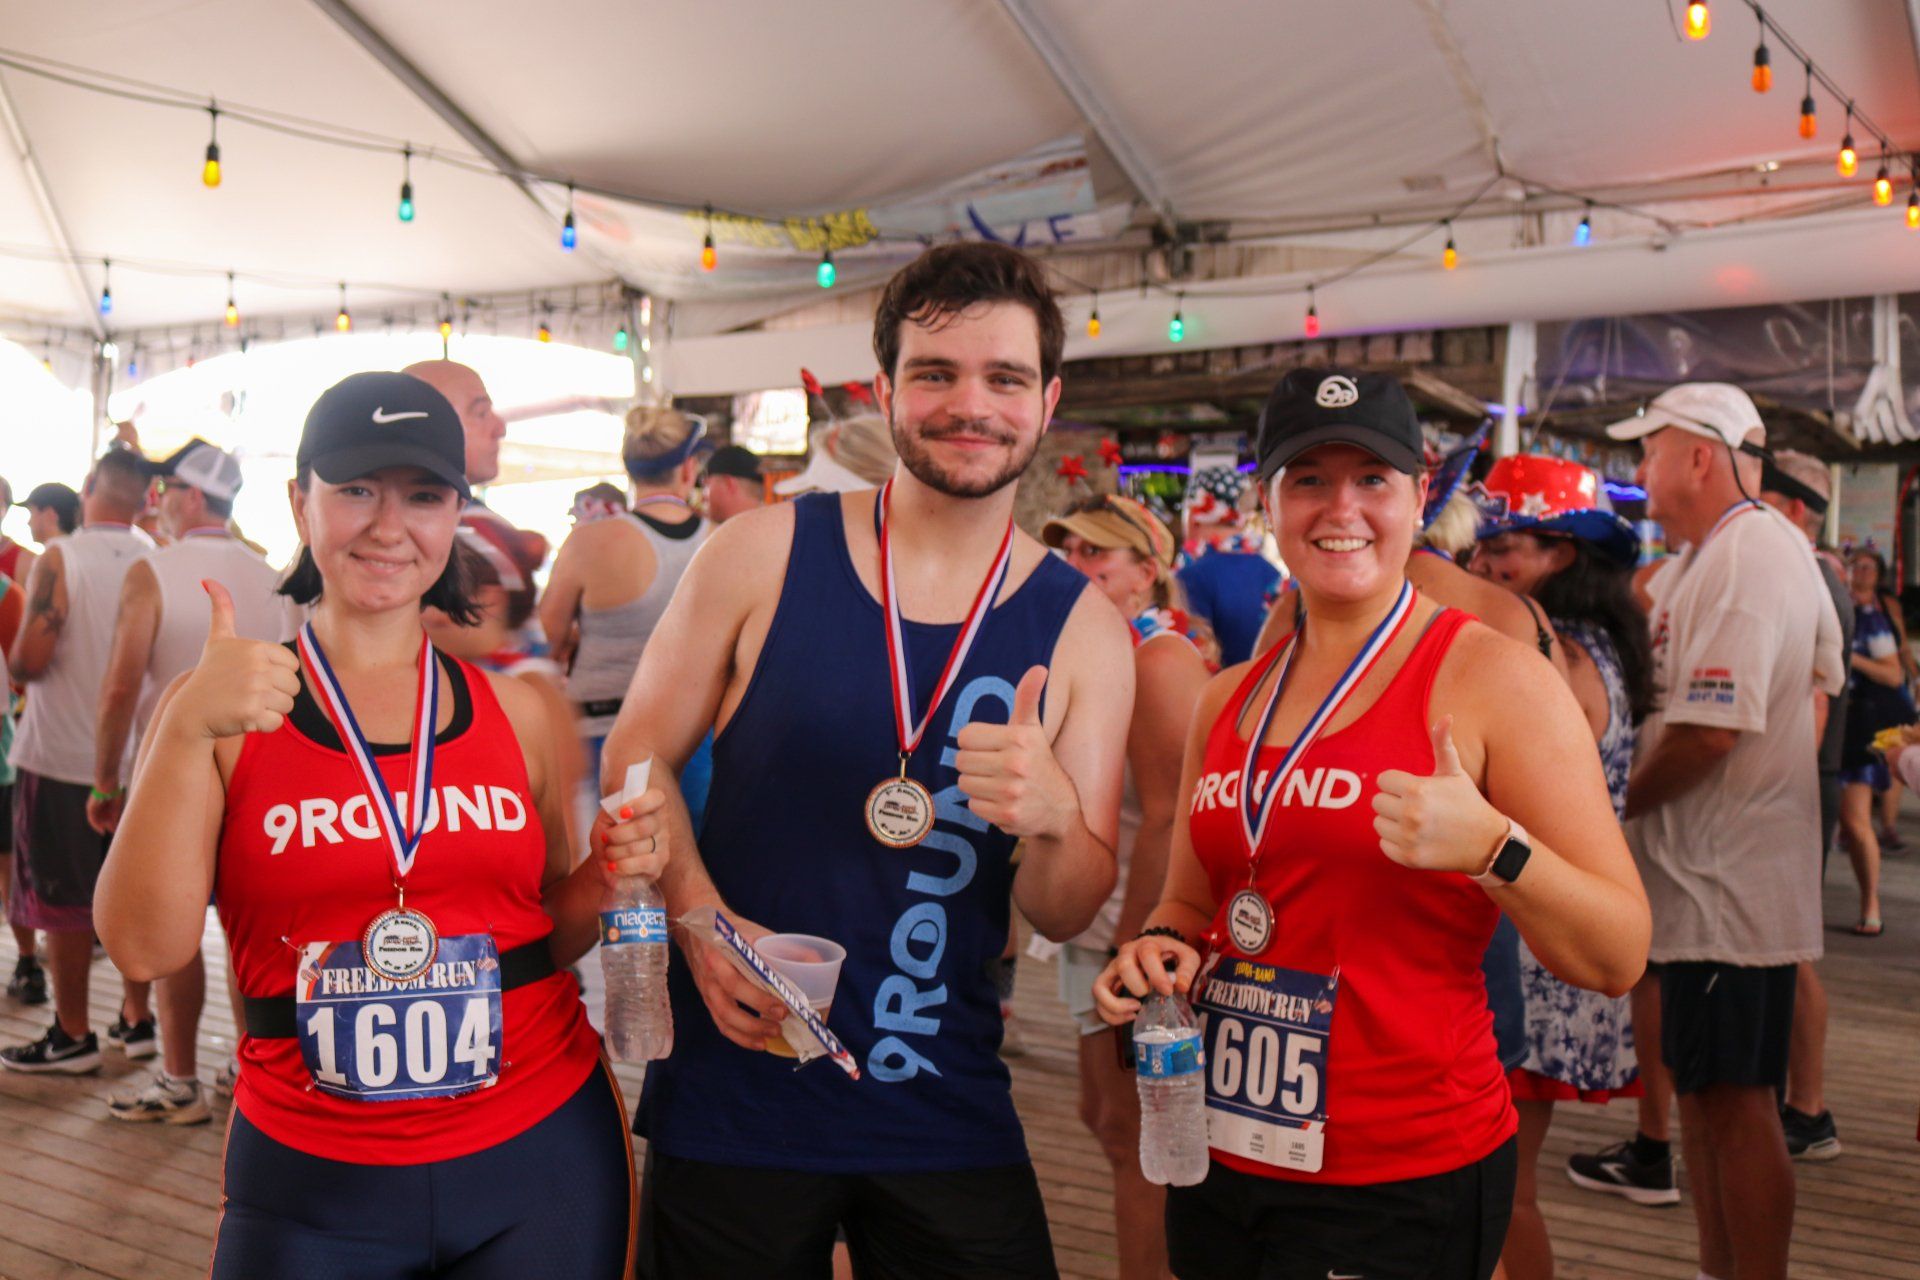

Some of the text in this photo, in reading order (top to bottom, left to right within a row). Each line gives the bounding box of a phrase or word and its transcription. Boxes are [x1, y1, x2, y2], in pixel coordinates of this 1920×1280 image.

[263, 784, 528, 856] 9ROUND
[432, 960, 478, 988] RUN
[1204, 978, 1313, 1024] FREEDOM RUN
[306, 997, 496, 1088] 1604
